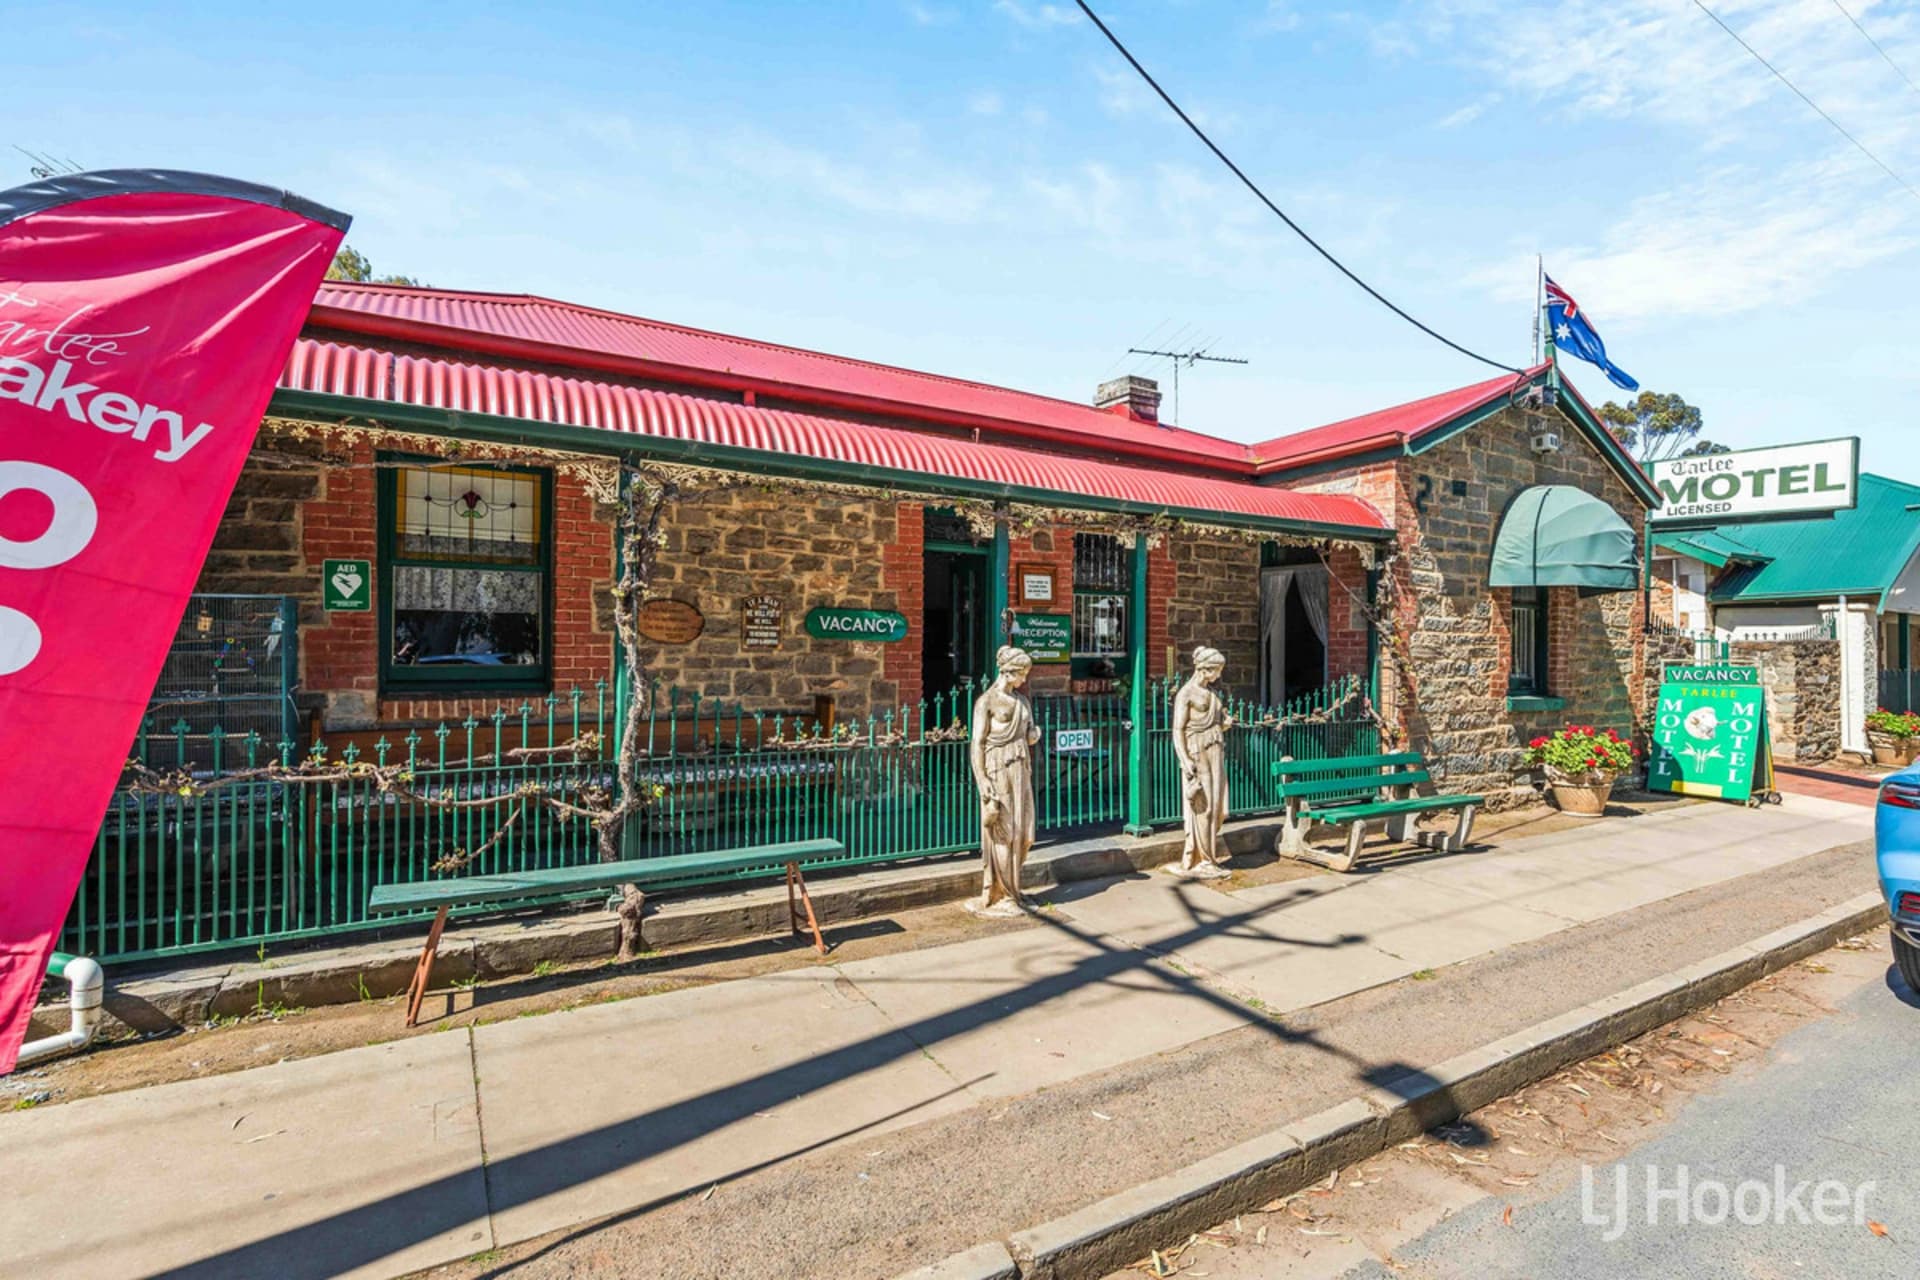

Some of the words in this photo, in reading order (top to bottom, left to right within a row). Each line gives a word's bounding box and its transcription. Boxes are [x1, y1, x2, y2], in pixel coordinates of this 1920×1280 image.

[0, 357, 215, 462] akery
[1671, 457, 1734, 476] Tarlee
[1658, 462, 1846, 504] MOTEL
[1667, 502, 1732, 516] LICENSED
[337, 564, 357, 573] AED
[819, 615, 898, 634] VACANCY
[1027, 618, 1059, 627] Welcome
[1671, 669, 1752, 681] VACANCY
[1680, 687, 1738, 698] TARLEE
[1058, 732, 1092, 748] OPEN
[1656, 698, 1684, 776] MOTEL
[1727, 702, 1756, 784] MOTEL
